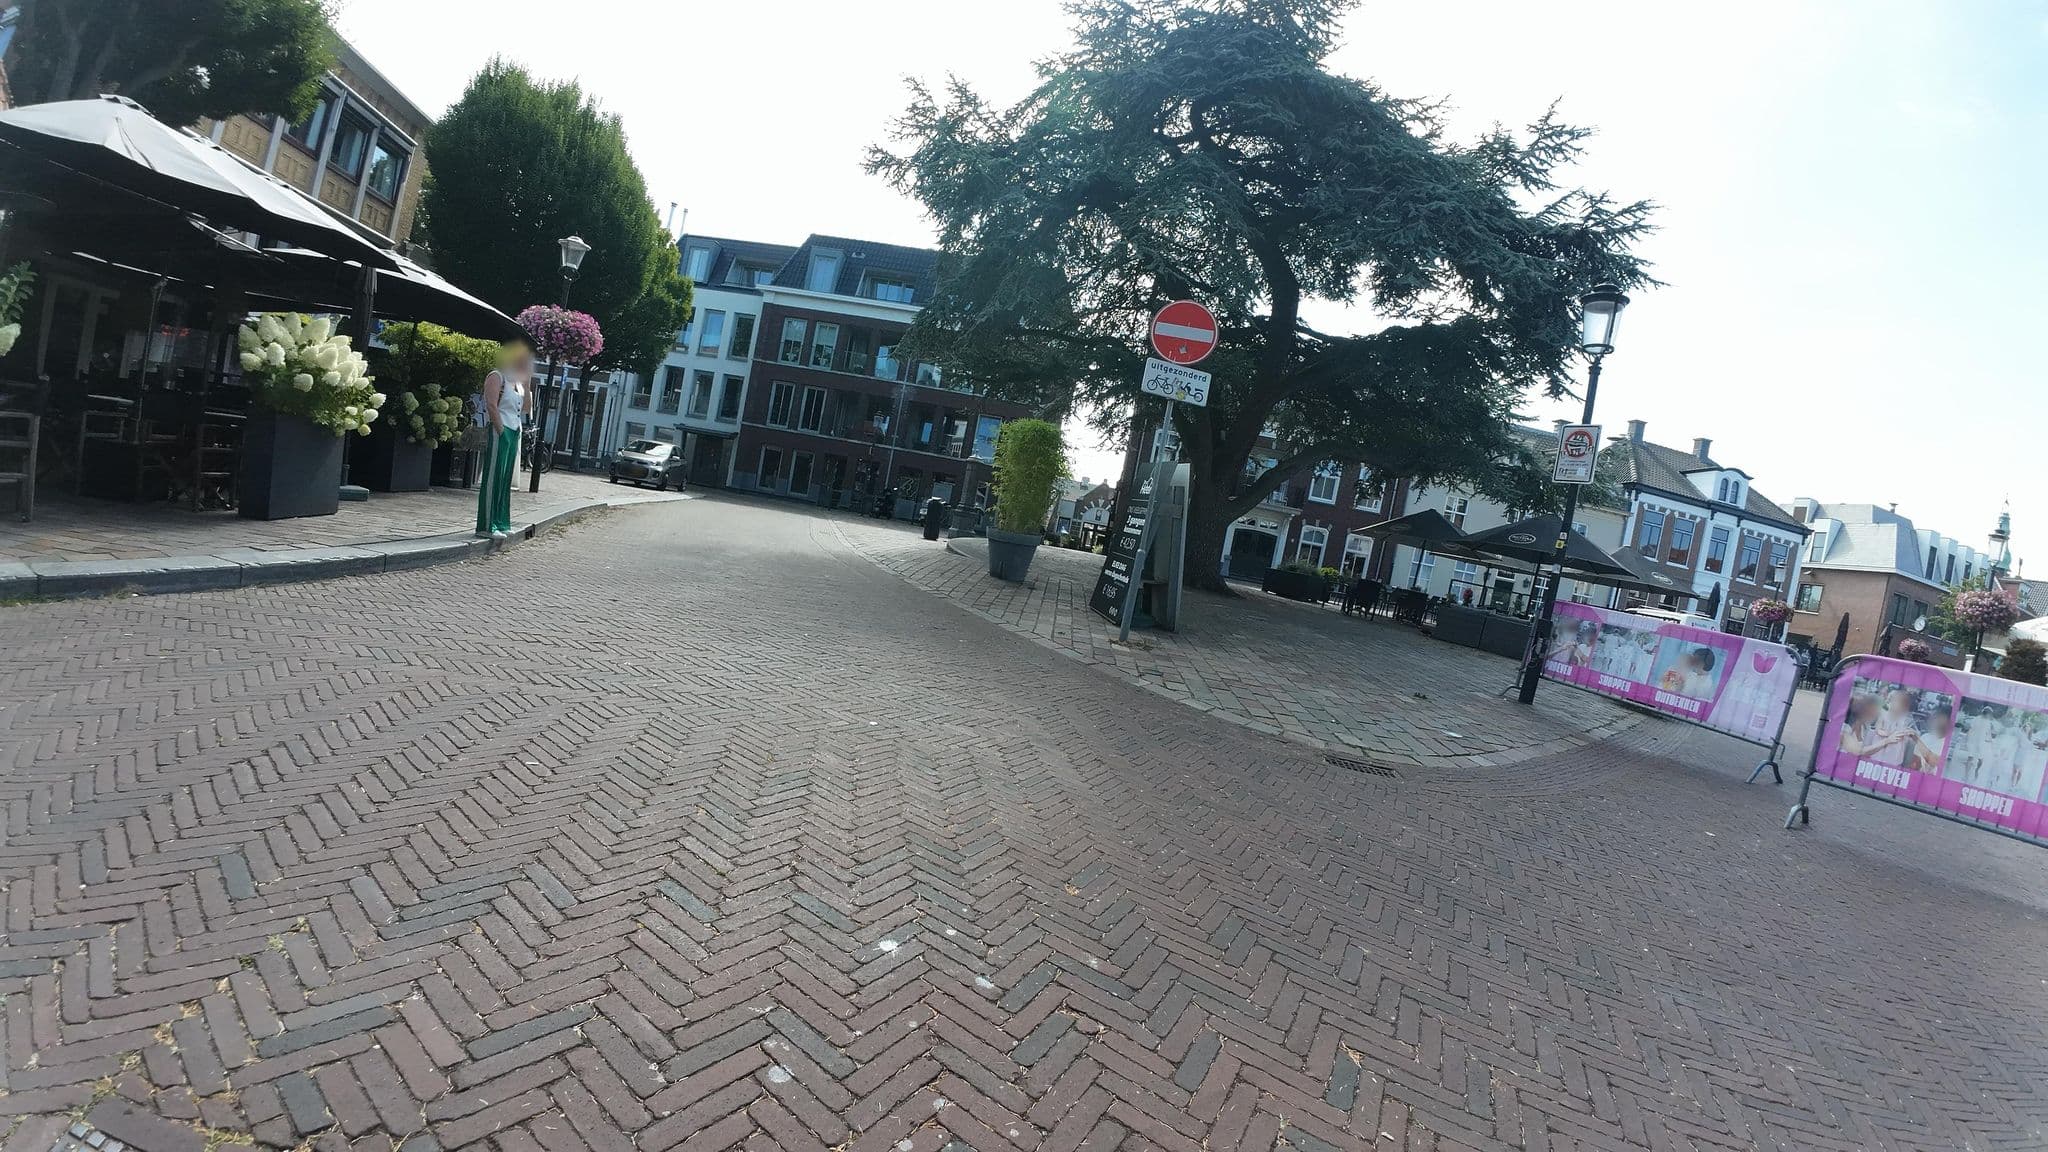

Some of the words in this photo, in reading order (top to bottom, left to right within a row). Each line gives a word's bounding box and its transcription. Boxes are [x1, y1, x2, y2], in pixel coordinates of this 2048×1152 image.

[1599, 674, 1632, 693] SHOPPEN
[1655, 690, 1701, 713] ONTDEKKEN
[1855, 760, 1911, 789] PROEVEN
[1959, 786, 2014, 816] SHOPPEN
